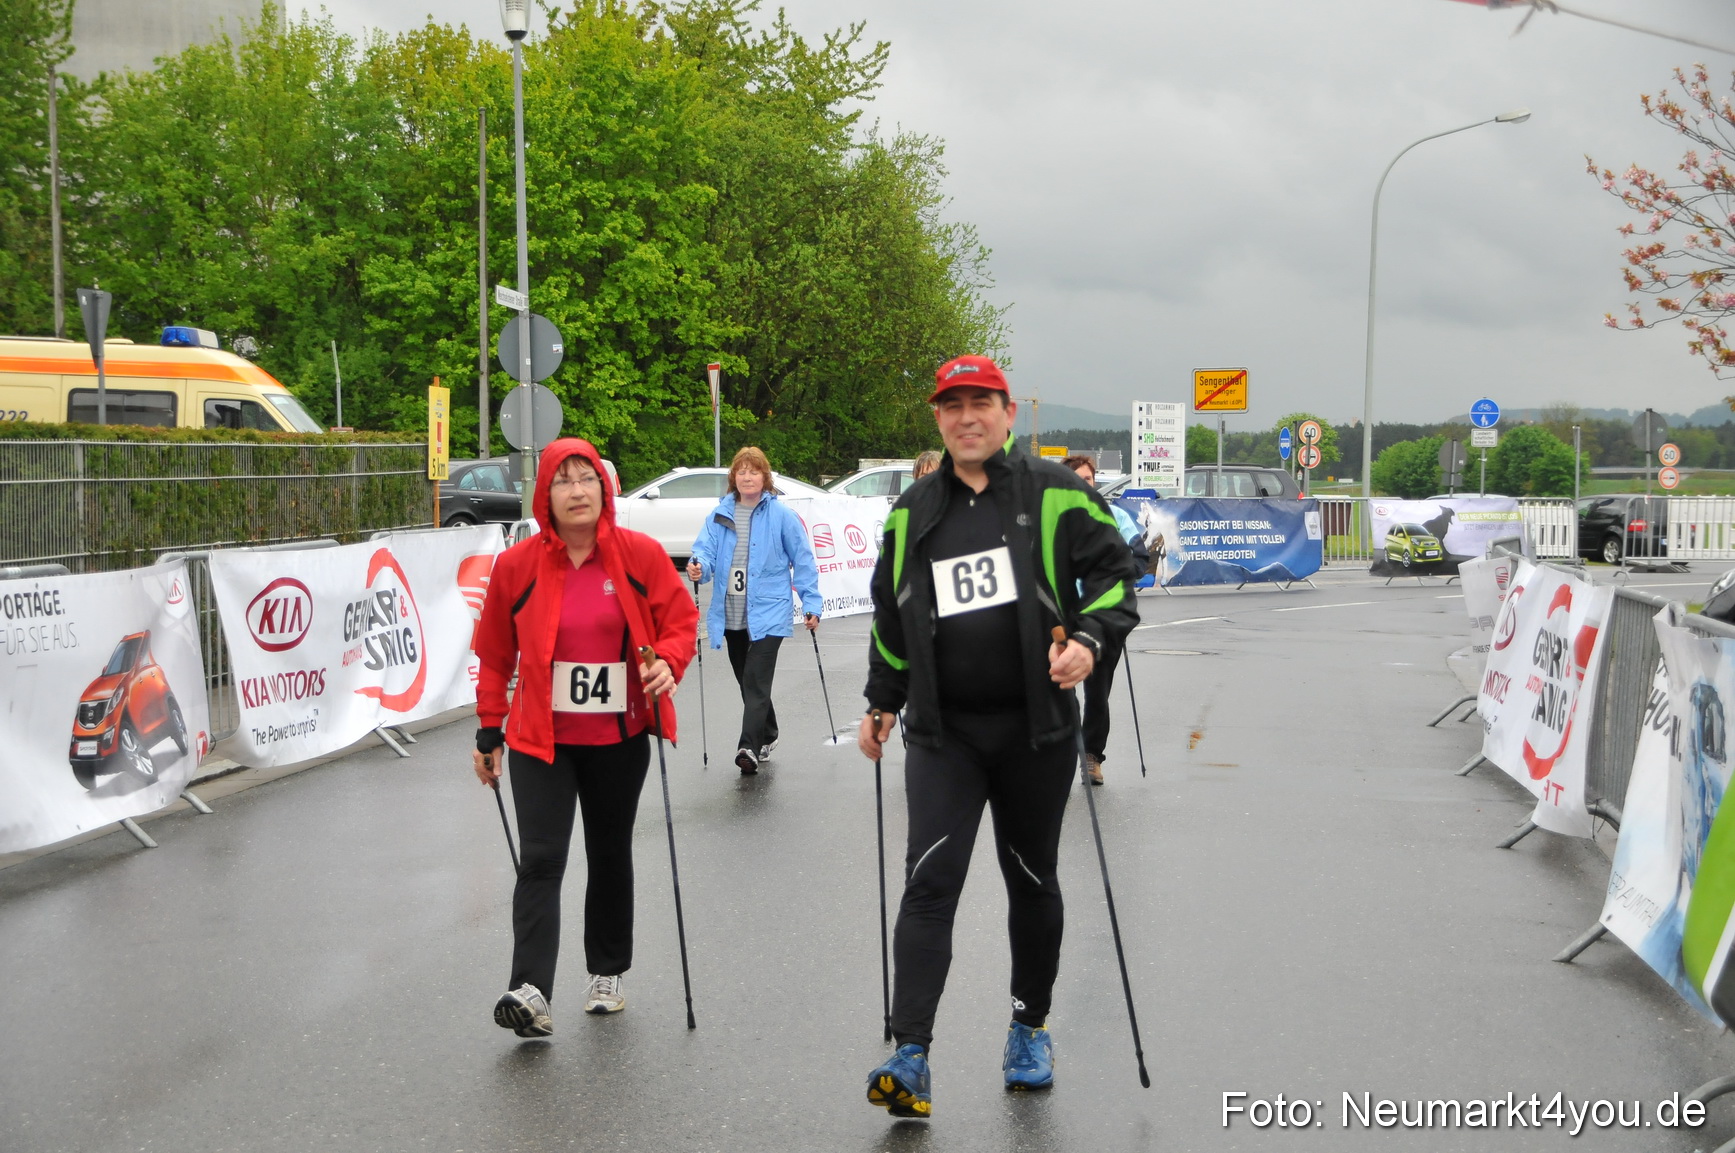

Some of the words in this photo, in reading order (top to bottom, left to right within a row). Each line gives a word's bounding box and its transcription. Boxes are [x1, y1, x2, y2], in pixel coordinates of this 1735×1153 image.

[1199, 376, 1242, 388] Sengenthal
[1304, 427, 1316, 438] 60
[1664, 450, 1676, 460] 60
[432, 459, 436, 477] 5
[437, 458, 446, 477] km
[1143, 462, 1160, 472] THULE
[1232, 520, 1243, 530] BEI
[848, 531, 864, 547] KIA
[1179, 536, 1198, 546] GANZ
[1200, 536, 1219, 545] WEIT
[1221, 535, 1245, 545] VORN
[1246, 535, 1258, 544] MIT
[1258, 534, 1285, 544] TOLLEN
[847, 559, 856, 569] KIA
[952, 556, 998, 604] 63
[0, 589, 66, 620] ORTAGE.
[399, 595, 408, 618] &
[258, 596, 303, 635] KIA
[29, 624, 50, 652] SIE
[53, 622, 80, 650] AUS.
[240, 677, 271, 709] KIA
[570, 665, 611, 705] 64
[289, 722, 296, 737] to
